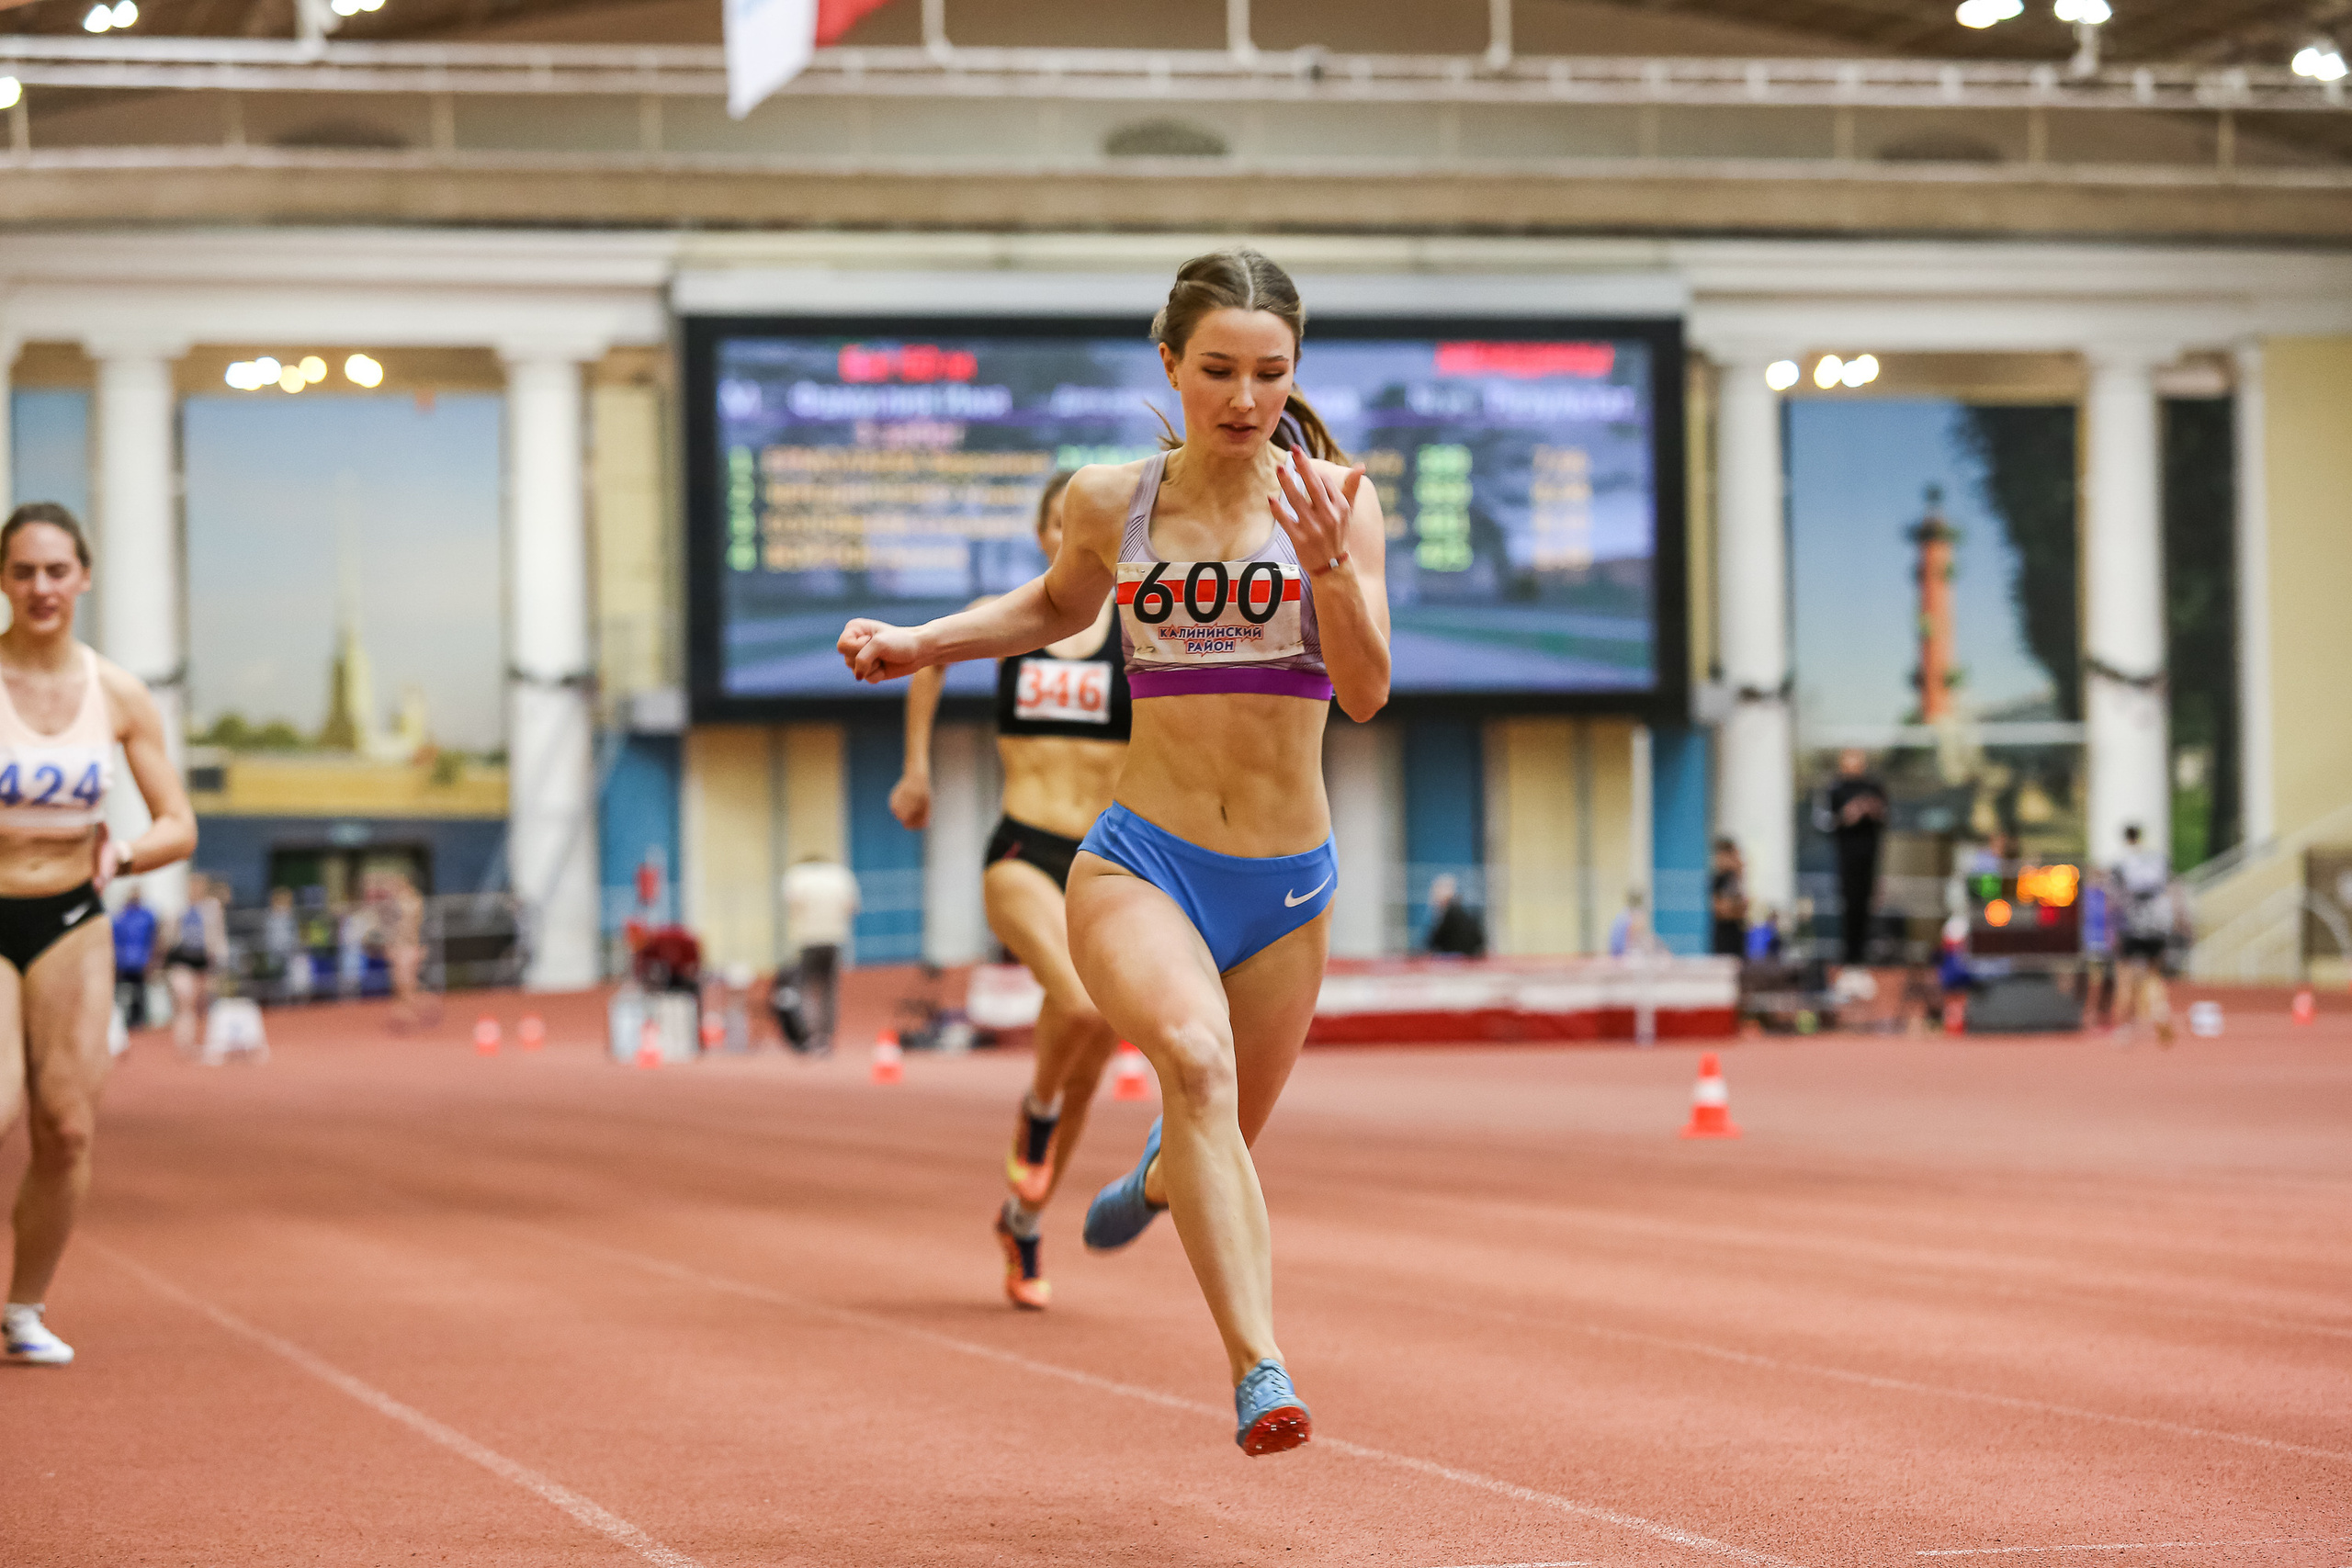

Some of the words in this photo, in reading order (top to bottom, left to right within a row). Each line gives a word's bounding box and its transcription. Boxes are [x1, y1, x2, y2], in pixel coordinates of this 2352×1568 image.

[1133, 561, 1283, 624] 600
[1159, 626, 1263, 639] КАЛИНИНСКИЙ
[1186, 639, 1235, 653] РАЙОН
[1017, 663, 1102, 712] 346
[0, 761, 102, 807] 424
